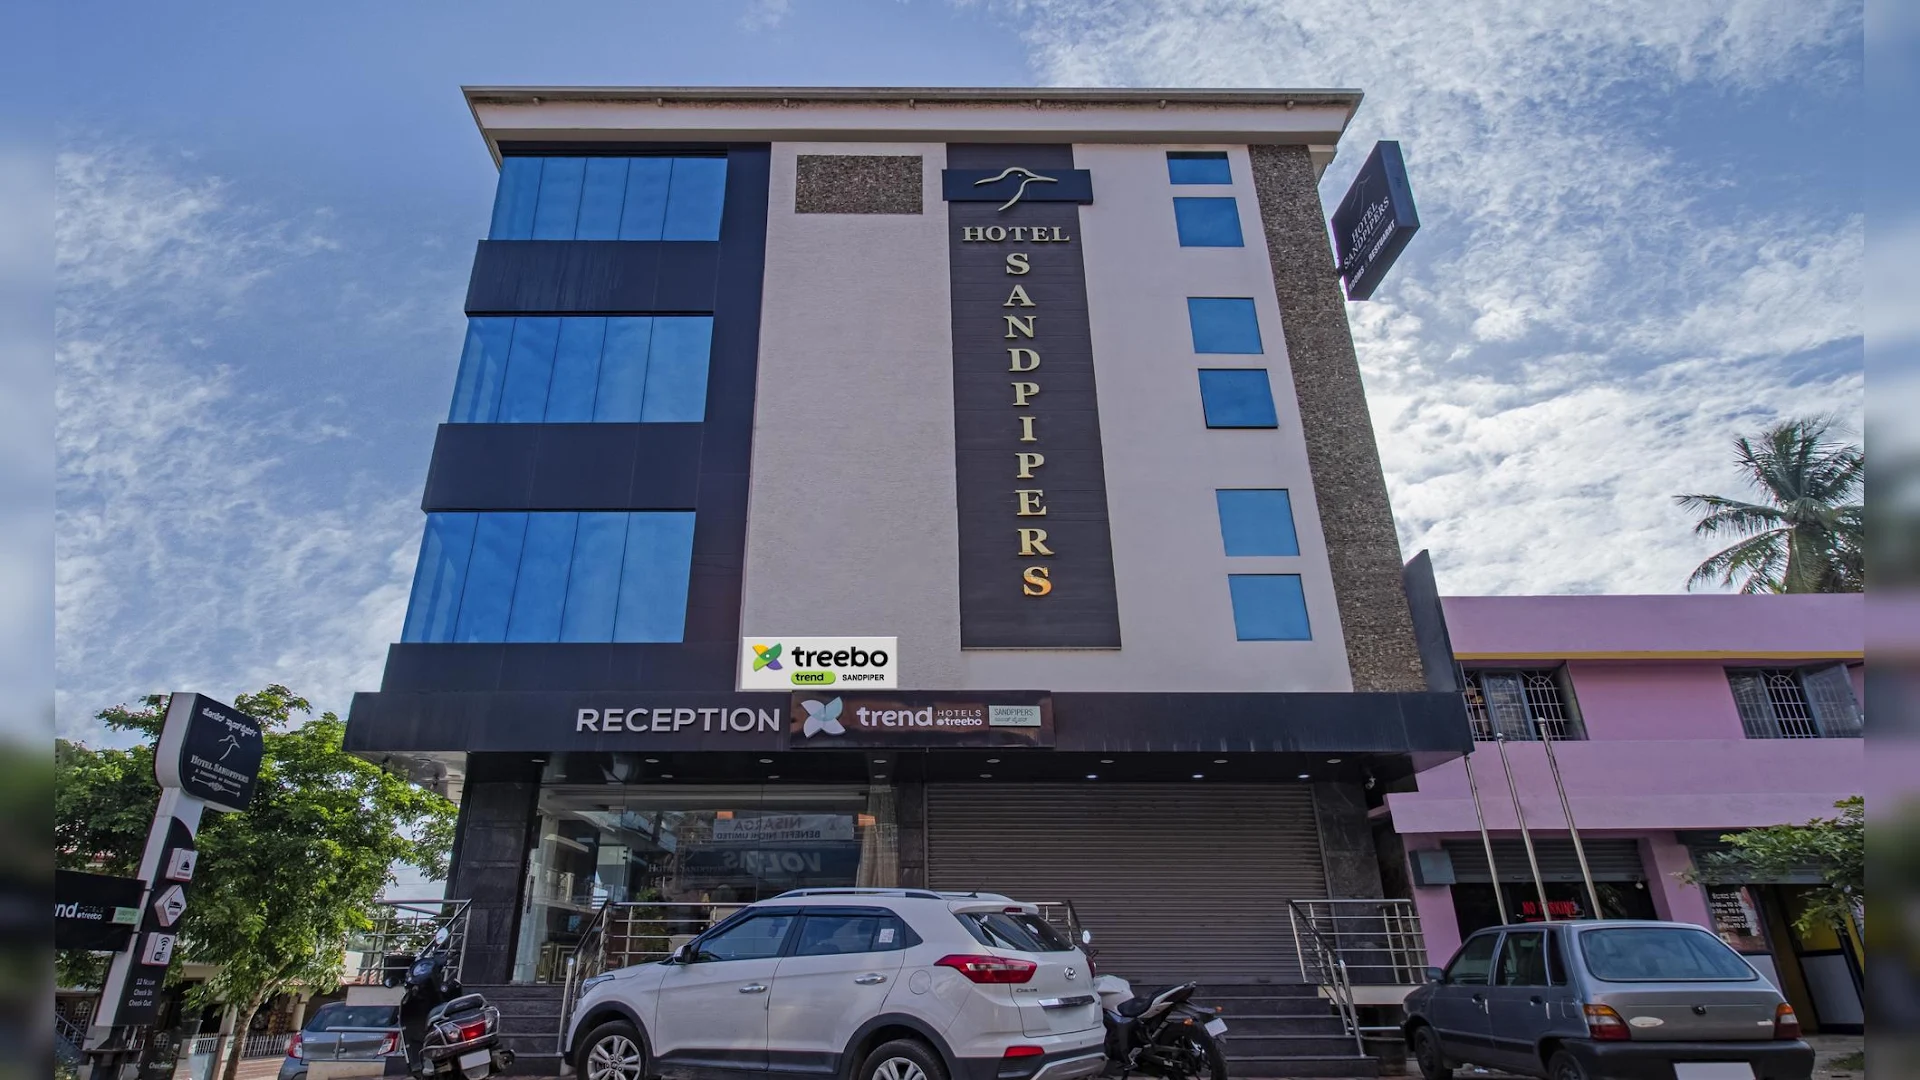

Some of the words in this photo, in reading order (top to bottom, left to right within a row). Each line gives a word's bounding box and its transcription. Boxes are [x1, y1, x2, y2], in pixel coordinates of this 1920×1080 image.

[1352, 203, 1378, 243] HOTEL
[962, 226, 1071, 243] HOTEL
[1343, 196, 1390, 270] SANDPIPERS
[1003, 252, 1054, 598] SANDPIPERS
[791, 646, 889, 668] treebo
[795, 672, 824, 682] trend
[842, 673, 885, 682] SANDPIPER
[575, 707, 781, 732] RECEPTION
[855, 706, 933, 727] trend
[937, 709, 982, 717] HOTELS
[944, 717, 983, 726] treebo
[994, 708, 1034, 716] SANDPIPERS
[1522, 901, 1536, 915] NO
